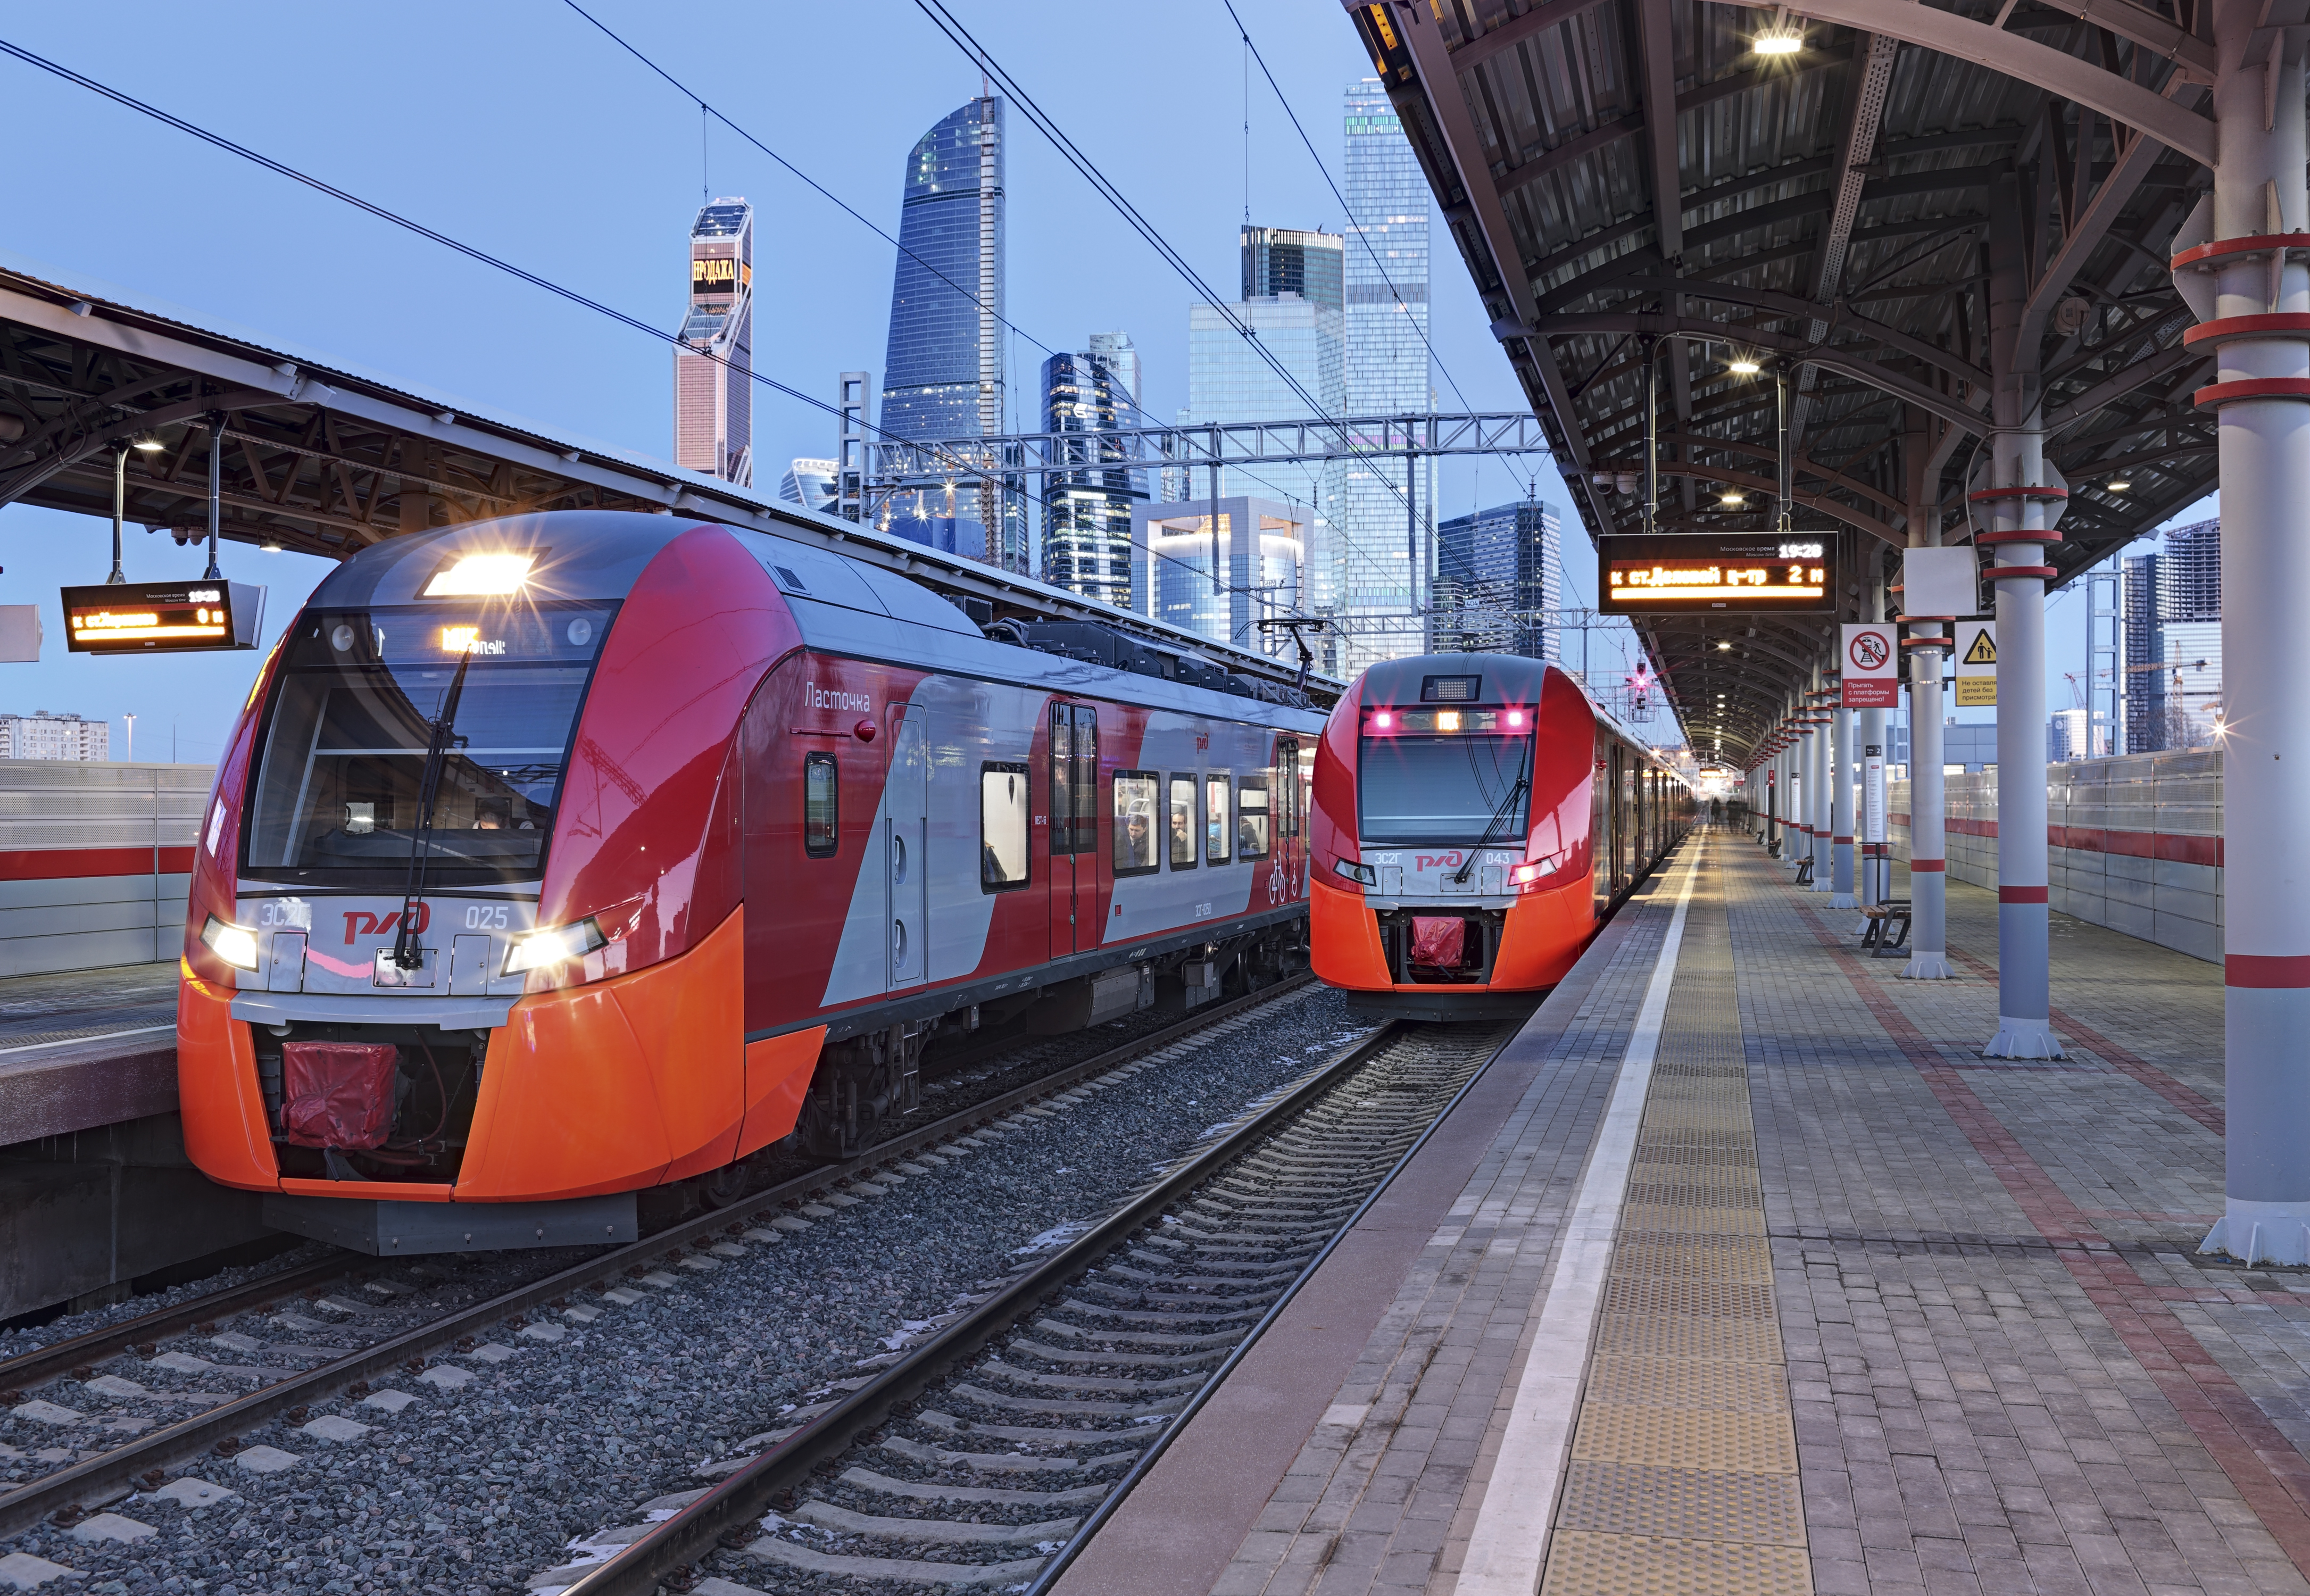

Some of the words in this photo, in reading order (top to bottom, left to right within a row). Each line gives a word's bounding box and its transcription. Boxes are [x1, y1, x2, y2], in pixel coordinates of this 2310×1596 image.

[693, 260, 734, 285] ПРОДАЖА
[1779, 545, 1822, 558] 19:28
[1611, 571, 1622, 584] к
[1789, 566, 1802, 582] 2
[804, 681, 870, 712] Ласточка
[1486, 852, 1510, 864] 043
[465, 906, 509, 930] 025
